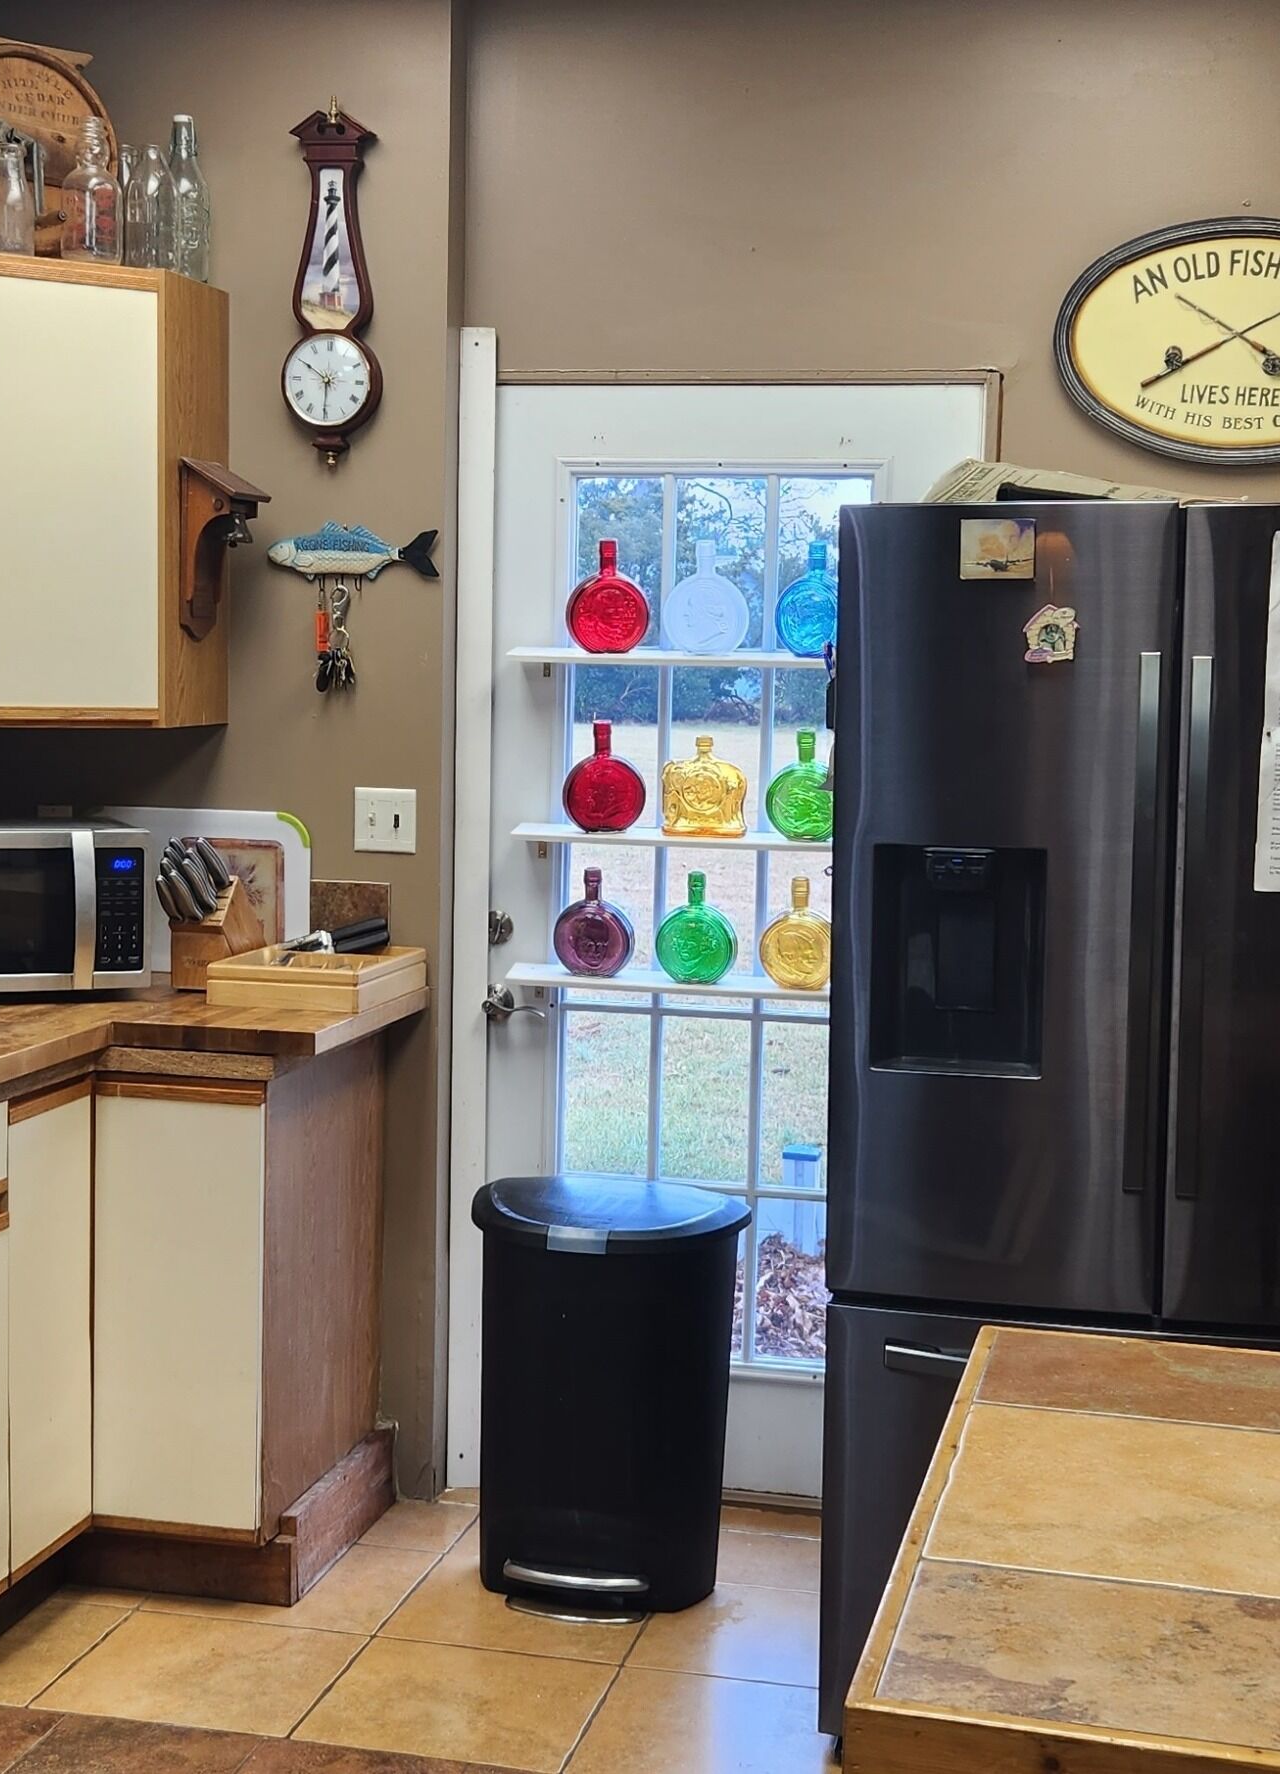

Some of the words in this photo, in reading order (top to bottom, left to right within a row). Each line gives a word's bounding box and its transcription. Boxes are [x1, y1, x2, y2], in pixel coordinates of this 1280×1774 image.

[15, 92, 65, 105] CEDAR
[41, 110, 80, 126] CHUR
[1132, 263, 1168, 304] AN
[1173, 251, 1220, 283] OLD
[1180, 384, 1230, 405] LIVES
[1134, 395, 1177, 420] WITH
[1183, 411, 1212, 428] HIS
[1222, 416, 1264, 430] BEST
